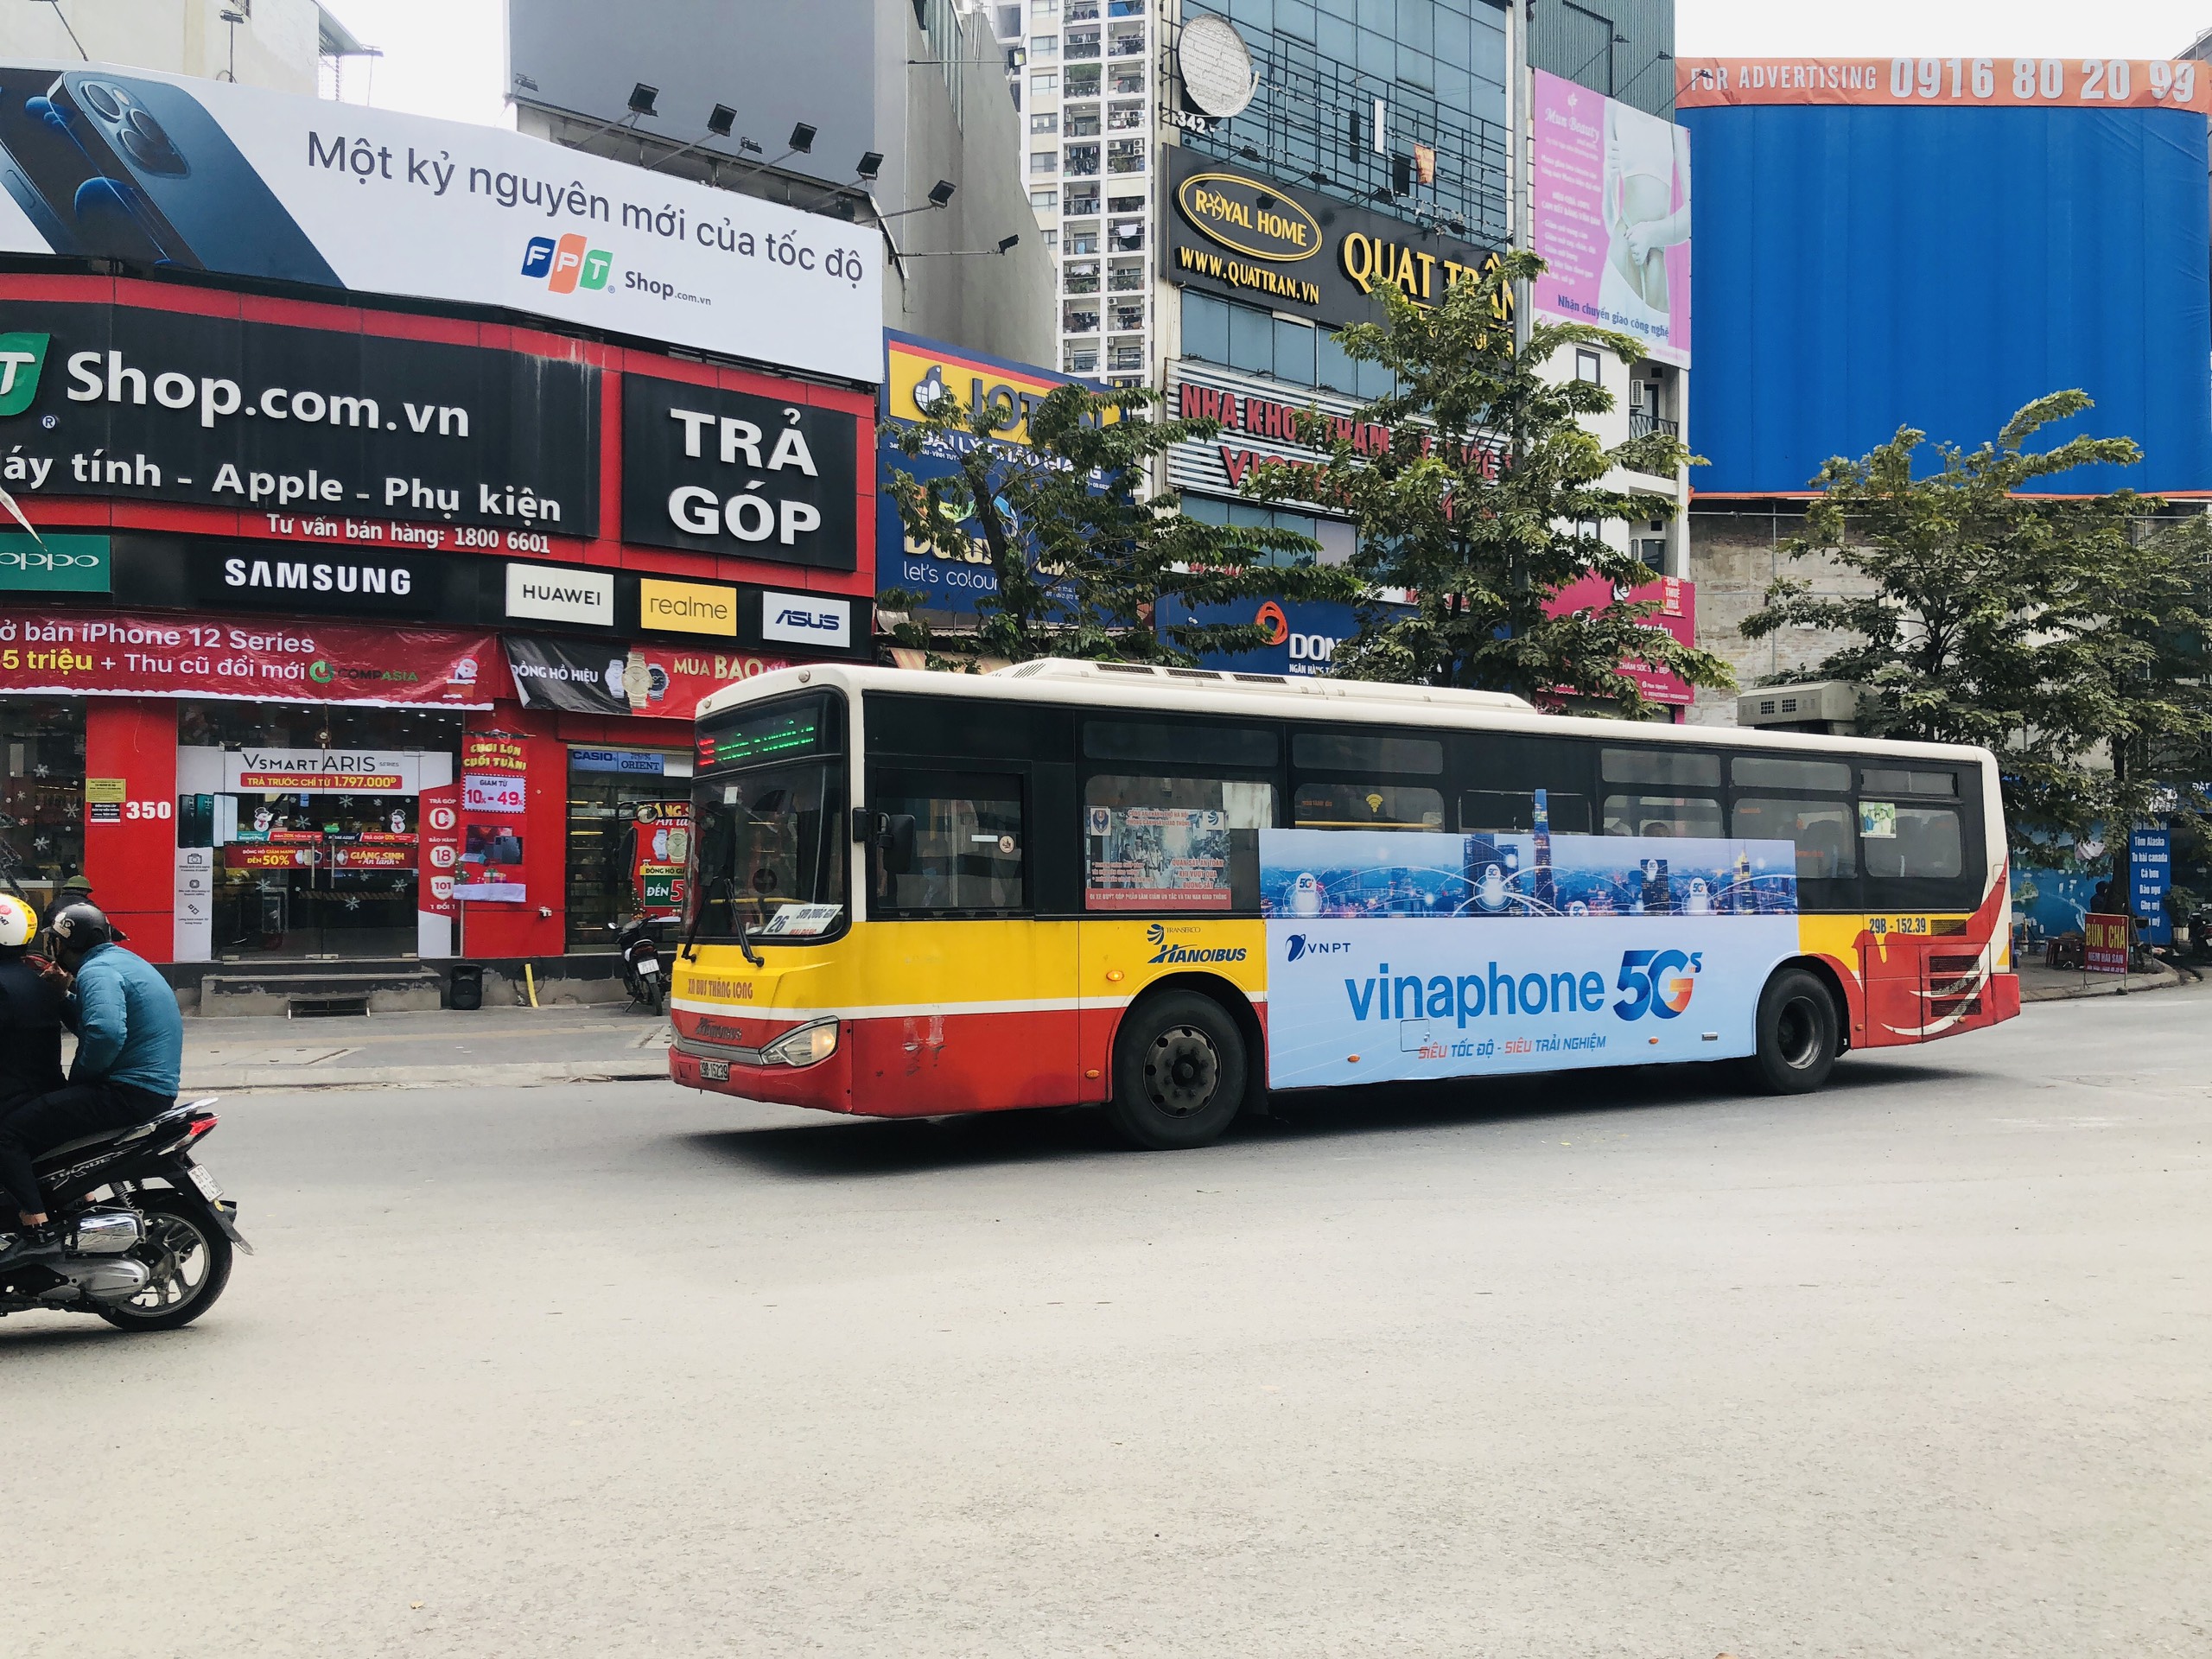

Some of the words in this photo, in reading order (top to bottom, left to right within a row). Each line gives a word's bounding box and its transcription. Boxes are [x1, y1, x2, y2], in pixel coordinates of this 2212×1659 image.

[1691, 67, 1728, 92] FOR
[1738, 65, 1877, 91] ADVERTISING
[1890, 57, 1994, 99] 0916
[2012, 58, 2064, 100] 80
[2080, 59, 2130, 101] 20
[2148, 60, 2195, 103] 99
[307, 130, 393, 186] Một
[406, 150, 457, 196] kỷ
[468, 166, 610, 223] nguyên
[621, 202, 685, 241] mới
[696, 217, 756, 257] của
[765, 229, 815, 271] tốc
[825, 244, 863, 289] độ
[1257, 210, 1308, 248] HOME
[1179, 245, 1320, 305] WWW.QUATTRAN.VN
[1344, 232, 1436, 299] QUAT
[1557, 294, 1580, 313] Nhận
[1611, 311, 1629, 326] giao
[1630, 318, 1649, 334] công
[1180, 383, 1239, 429] NHA
[1245, 397, 1314, 445] KHO
[670, 407, 819, 478] TRẢ
[71, 448, 162, 487] tính
[211, 461, 344, 505] Apple
[385, 477, 460, 519] Phụ
[479, 483, 561, 527] kiện
[667, 480, 822, 545] GÓP
[266, 513, 295, 535] Tư
[302, 515, 338, 537] vấn
[346, 518, 383, 540] bán
[390, 521, 445, 550] hàng:
[454, 527, 499, 548] 1800
[506, 531, 550, 555] 6601
[225, 557, 412, 595] SAMSUNG
[903, 560, 939, 583] let's
[522, 582, 601, 607] HUAWEI
[650, 595, 728, 620] realme
[775, 608, 840, 631] ASUS
[24, 620, 74, 643] bán
[82, 622, 181, 646] iPhone
[188, 627, 221, 648] 12
[229, 629, 316, 654] Series
[27, 649, 93, 676] triệu
[124, 654, 173, 673] Thu
[180, 654, 211, 676] cũ
[216, 653, 255, 678] đổi
[261, 659, 306, 681] mới
[338, 667, 419, 682] COMPASIA
[549, 664, 569, 681] HỒ
[571, 667, 599, 686] HIỆU
[673, 657, 710, 677] MUA
[714, 655, 763, 681] BAO
[321, 755, 377, 772] ARIS
[572, 750, 613, 762] CASIO
[620, 760, 660, 770] ORIENT
[125, 801, 172, 820] 350
[262, 855, 290, 866] 50%
[435, 849, 451, 862] 18
[435, 881, 451, 891] 101
[646, 882, 669, 897] ĐẾN
[766, 915, 790, 933] 26
[1868, 918, 1887, 934] 29B
[1896, 918, 1927, 934] 152.39
[2085, 918, 2104, 948] BÚN
[1147, 944, 1247, 963] HANOIBUS
[1306, 942, 1351, 953] VNPT
[696, 979, 708, 996] BUS
[709, 976, 731, 999] THĂNG
[733, 982, 753, 1000] LONG
[1344, 961, 1605, 1030] vinaphone
[1418, 1041, 1448, 1059] SIÊU
[1451, 1038, 1473, 1058] TỐC
[1476, 1038, 1496, 1059] ĐỘ
[1504, 1036, 1533, 1054] SIÊU
[1535, 1033, 1560, 1052] TRẢI
[1563, 1032, 1607, 1052] NGHIỆM
